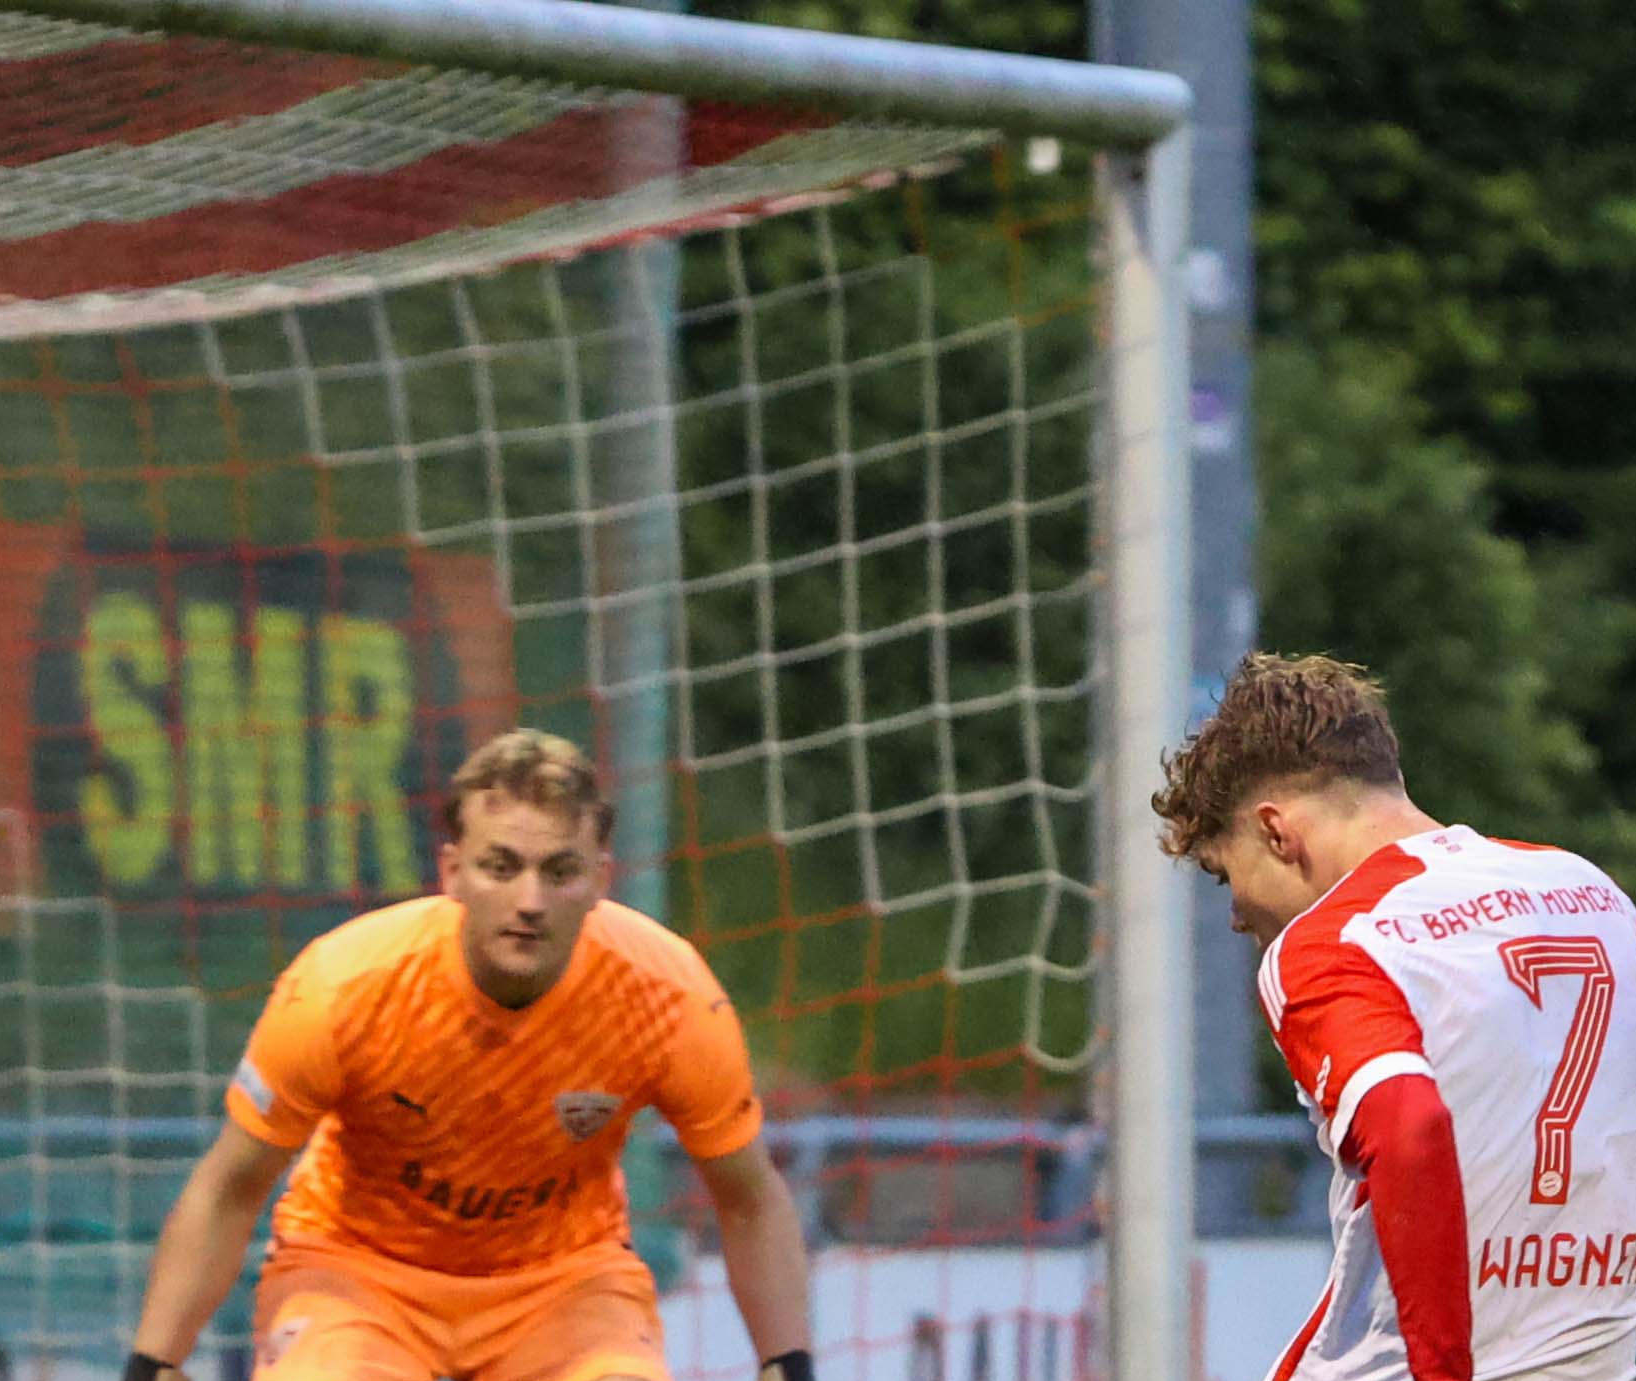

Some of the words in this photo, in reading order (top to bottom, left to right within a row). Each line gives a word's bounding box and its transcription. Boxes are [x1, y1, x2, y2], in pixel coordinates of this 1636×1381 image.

[81, 590, 425, 894] SMR
[1375, 918, 1417, 944] FC
[1420, 887, 1537, 941] BAYERN
[1497, 934, 1616, 1206] 7
